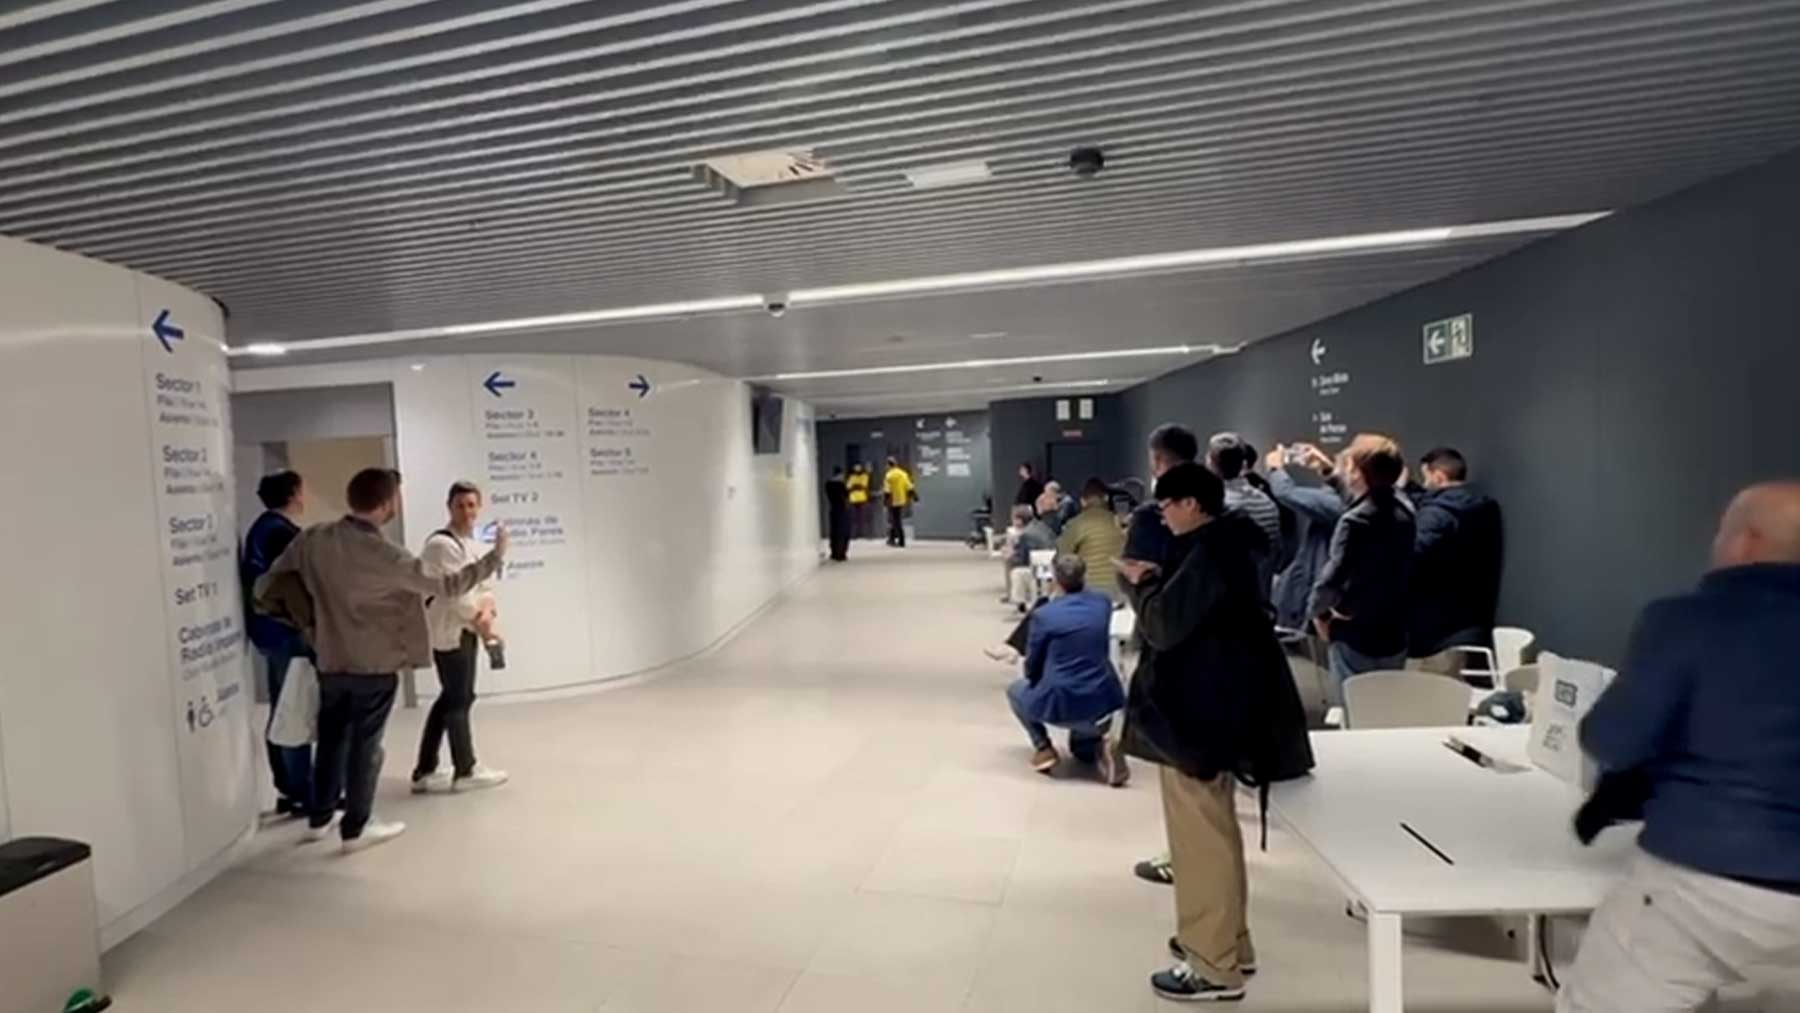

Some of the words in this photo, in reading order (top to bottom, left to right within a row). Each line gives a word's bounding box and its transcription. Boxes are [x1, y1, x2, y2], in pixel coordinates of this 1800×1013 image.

[156, 372, 193, 393] Sector
[485, 409, 525, 420] Sector
[162, 444, 199, 463] Sector
[488, 451, 527, 462] Sector
[168, 516, 207, 535] Sector
[175, 586, 197, 606] Set
